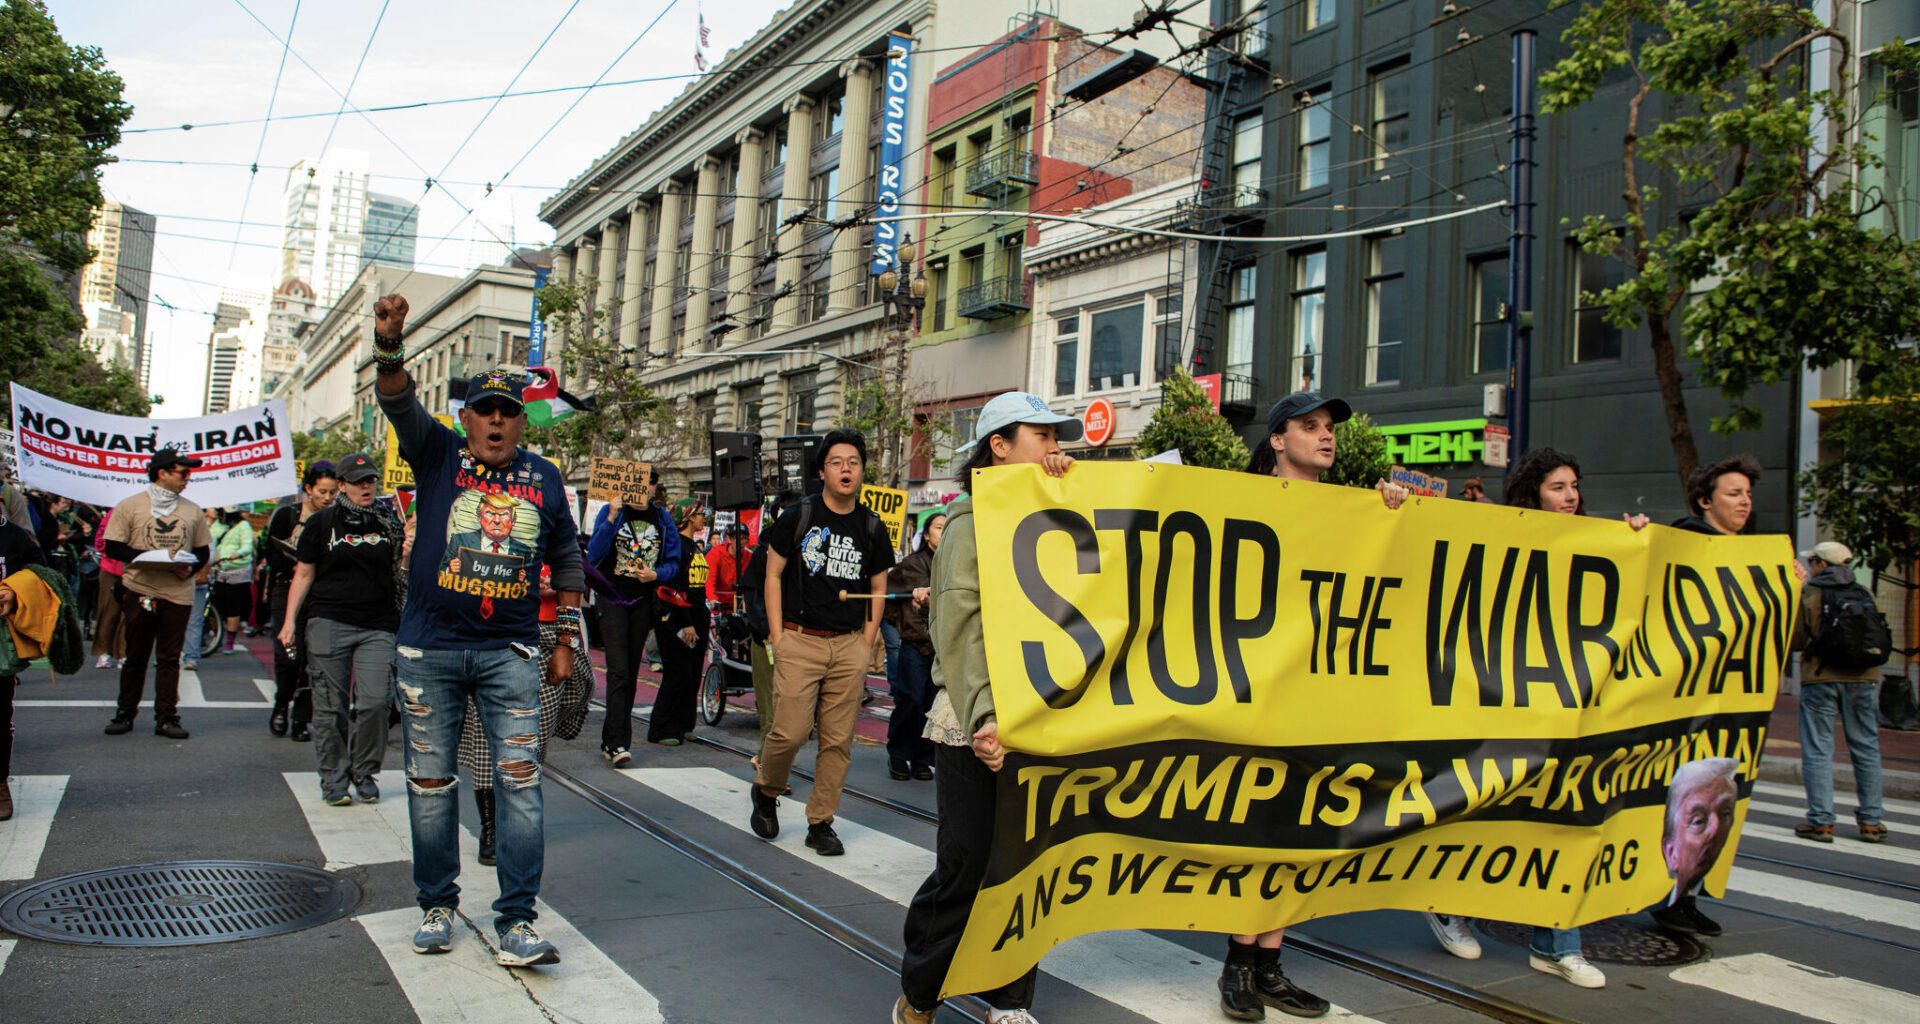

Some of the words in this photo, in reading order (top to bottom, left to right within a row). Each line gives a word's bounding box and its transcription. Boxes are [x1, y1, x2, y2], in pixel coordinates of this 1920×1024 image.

[885, 45, 907, 145] ROSS
[876, 165, 899, 266] ROSS
[1090, 411, 1103, 421] THE
[20, 404, 70, 441] NO
[75, 427, 157, 453] WAR
[194, 415, 277, 451] IRAN
[1087, 419, 1107, 432] MELT
[23, 432, 99, 465] REGISTER
[201, 439, 275, 467] FREEDOM
[228, 469, 244, 478] VOTE
[595, 458, 625, 472] Trump's
[626, 463, 648, 475] Claim
[111, 475, 130, 484] Party
[387, 470, 402, 481] TO
[1393, 470, 1427, 488] KOREANS
[1431, 480, 1445, 492] SAY
[592, 479, 608, 489] like
[612, 483, 618, 491] a
[508, 484, 543, 508] HIM
[622, 493, 643, 504] CALL
[864, 490, 903, 514] STOP
[830, 533, 855, 550] U.S.
[828, 547, 848, 561] OUT
[848, 550, 862, 563] OF
[472, 560, 490, 576] by
[493, 564, 512, 577] the
[826, 558, 861, 580] KOREA
[1012, 508, 1280, 710] STOP
[1300, 569, 1402, 676] THE
[1426, 540, 1620, 709] WAR
[1662, 563, 1793, 698] IRAN
[1017, 755, 1288, 843] TRUMP
[1299, 763, 1375, 826] IS
[1385, 760, 1436, 827] A
[1452, 755, 1594, 816] WAR
